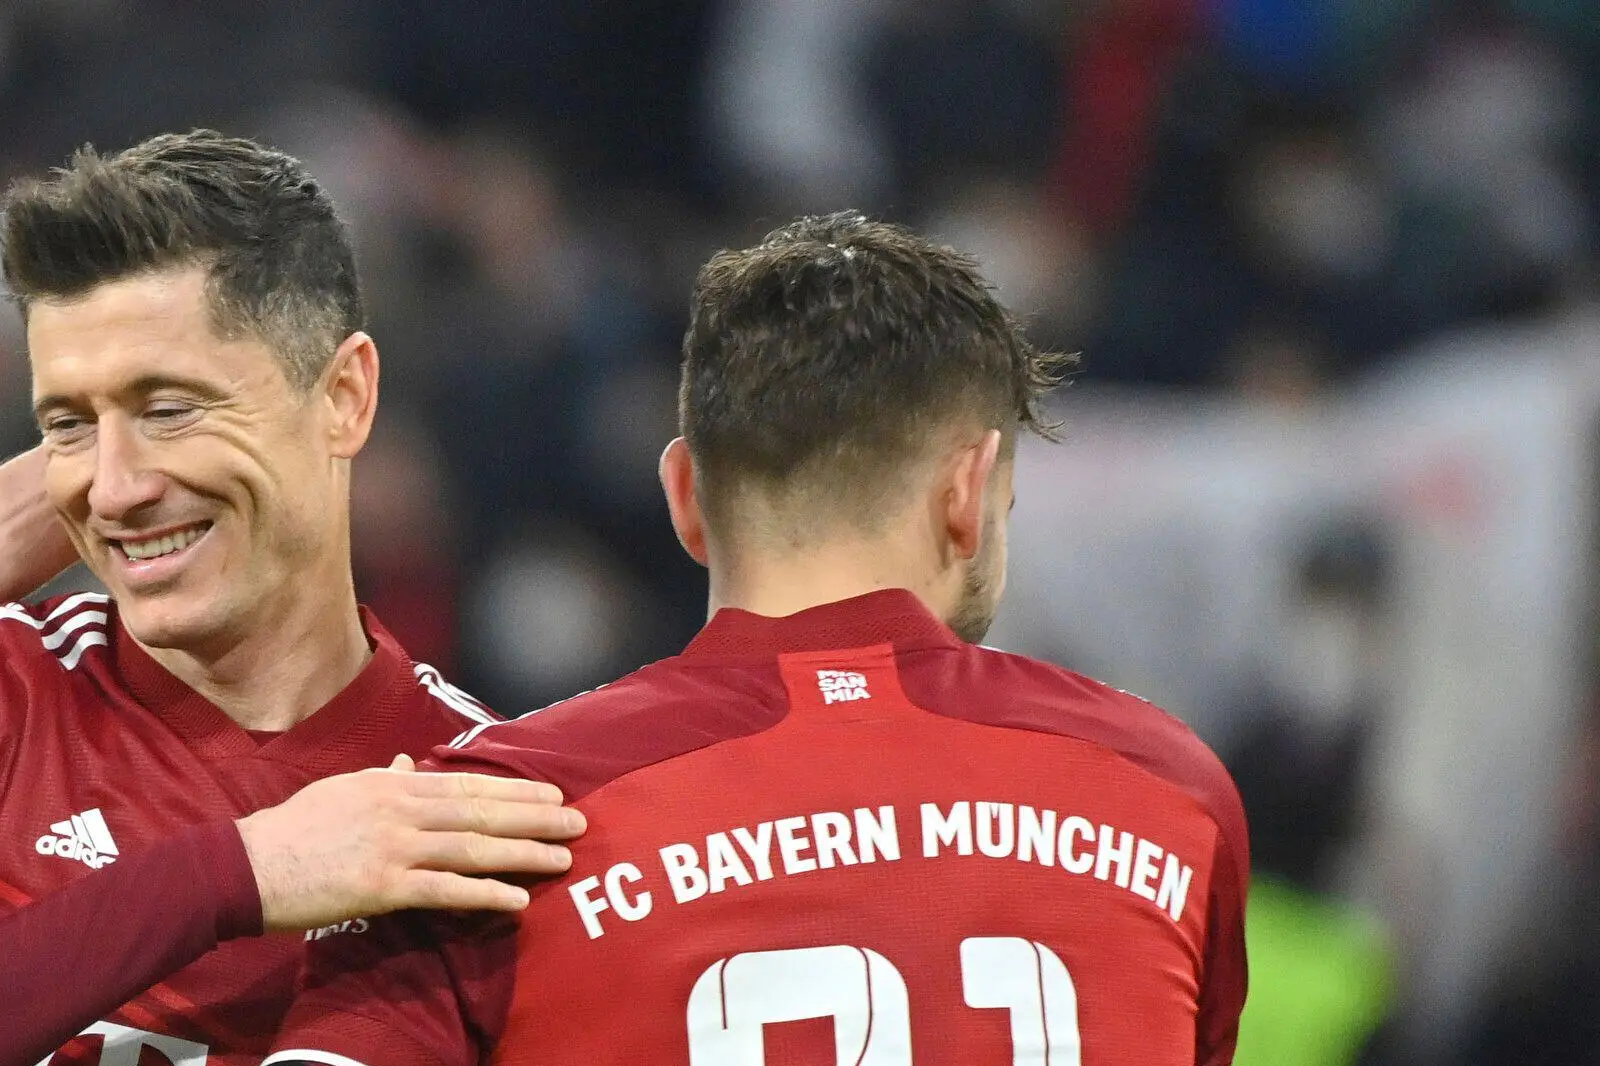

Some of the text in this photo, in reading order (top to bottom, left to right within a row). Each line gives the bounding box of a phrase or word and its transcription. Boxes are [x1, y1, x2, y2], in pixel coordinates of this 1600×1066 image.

[823, 688, 871, 705] MIA
[567, 801, 1194, 939] FC BAYERN MÜNCHEN
